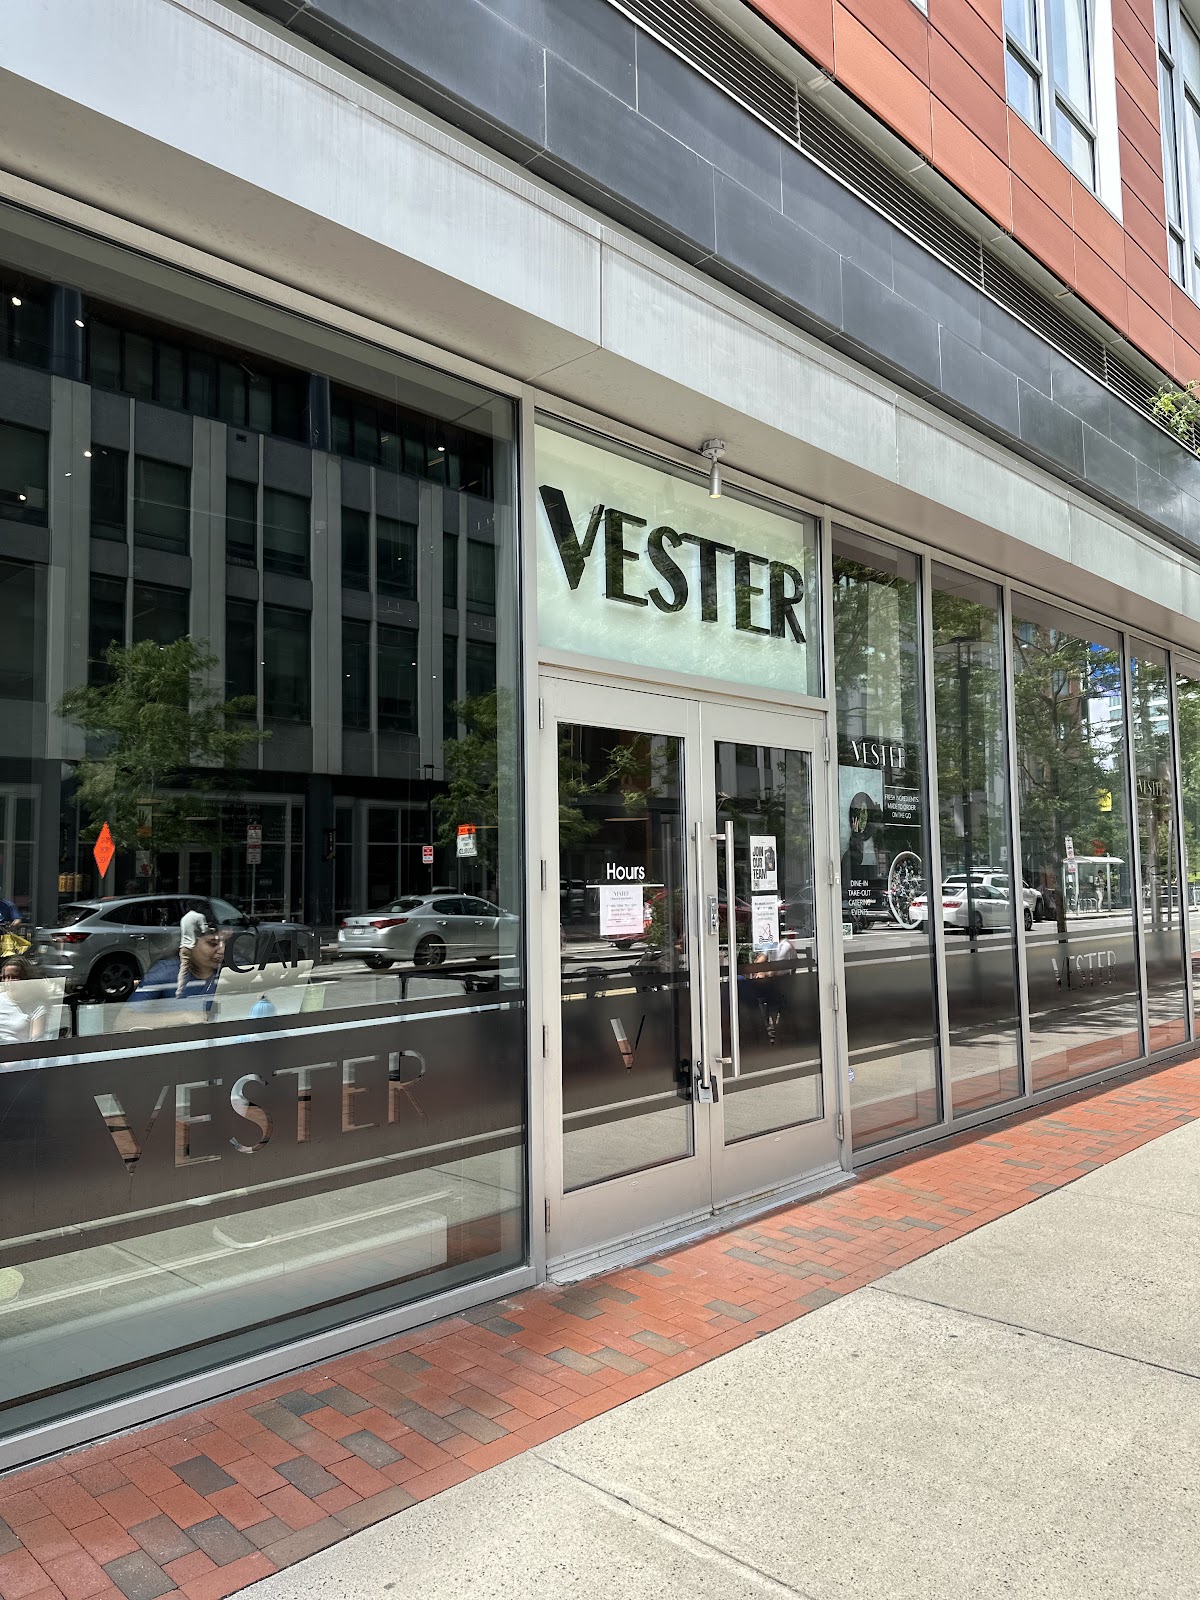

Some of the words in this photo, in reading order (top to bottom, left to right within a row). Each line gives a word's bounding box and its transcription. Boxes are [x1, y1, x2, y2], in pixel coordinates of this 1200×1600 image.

[538, 484, 807, 644] VESTER
[851, 740, 906, 769] VESTER
[752, 846, 764, 857] JOIN
[752, 858, 763, 868] OUR
[606, 862, 646, 880] Hours
[752, 869, 768, 880] TEAM
[847, 889, 871, 897] TAKE-OUT
[851, 908, 869, 916] EVENTS
[1051, 950, 1118, 992] VESTER
[93, 1050, 428, 1178] VESTER
